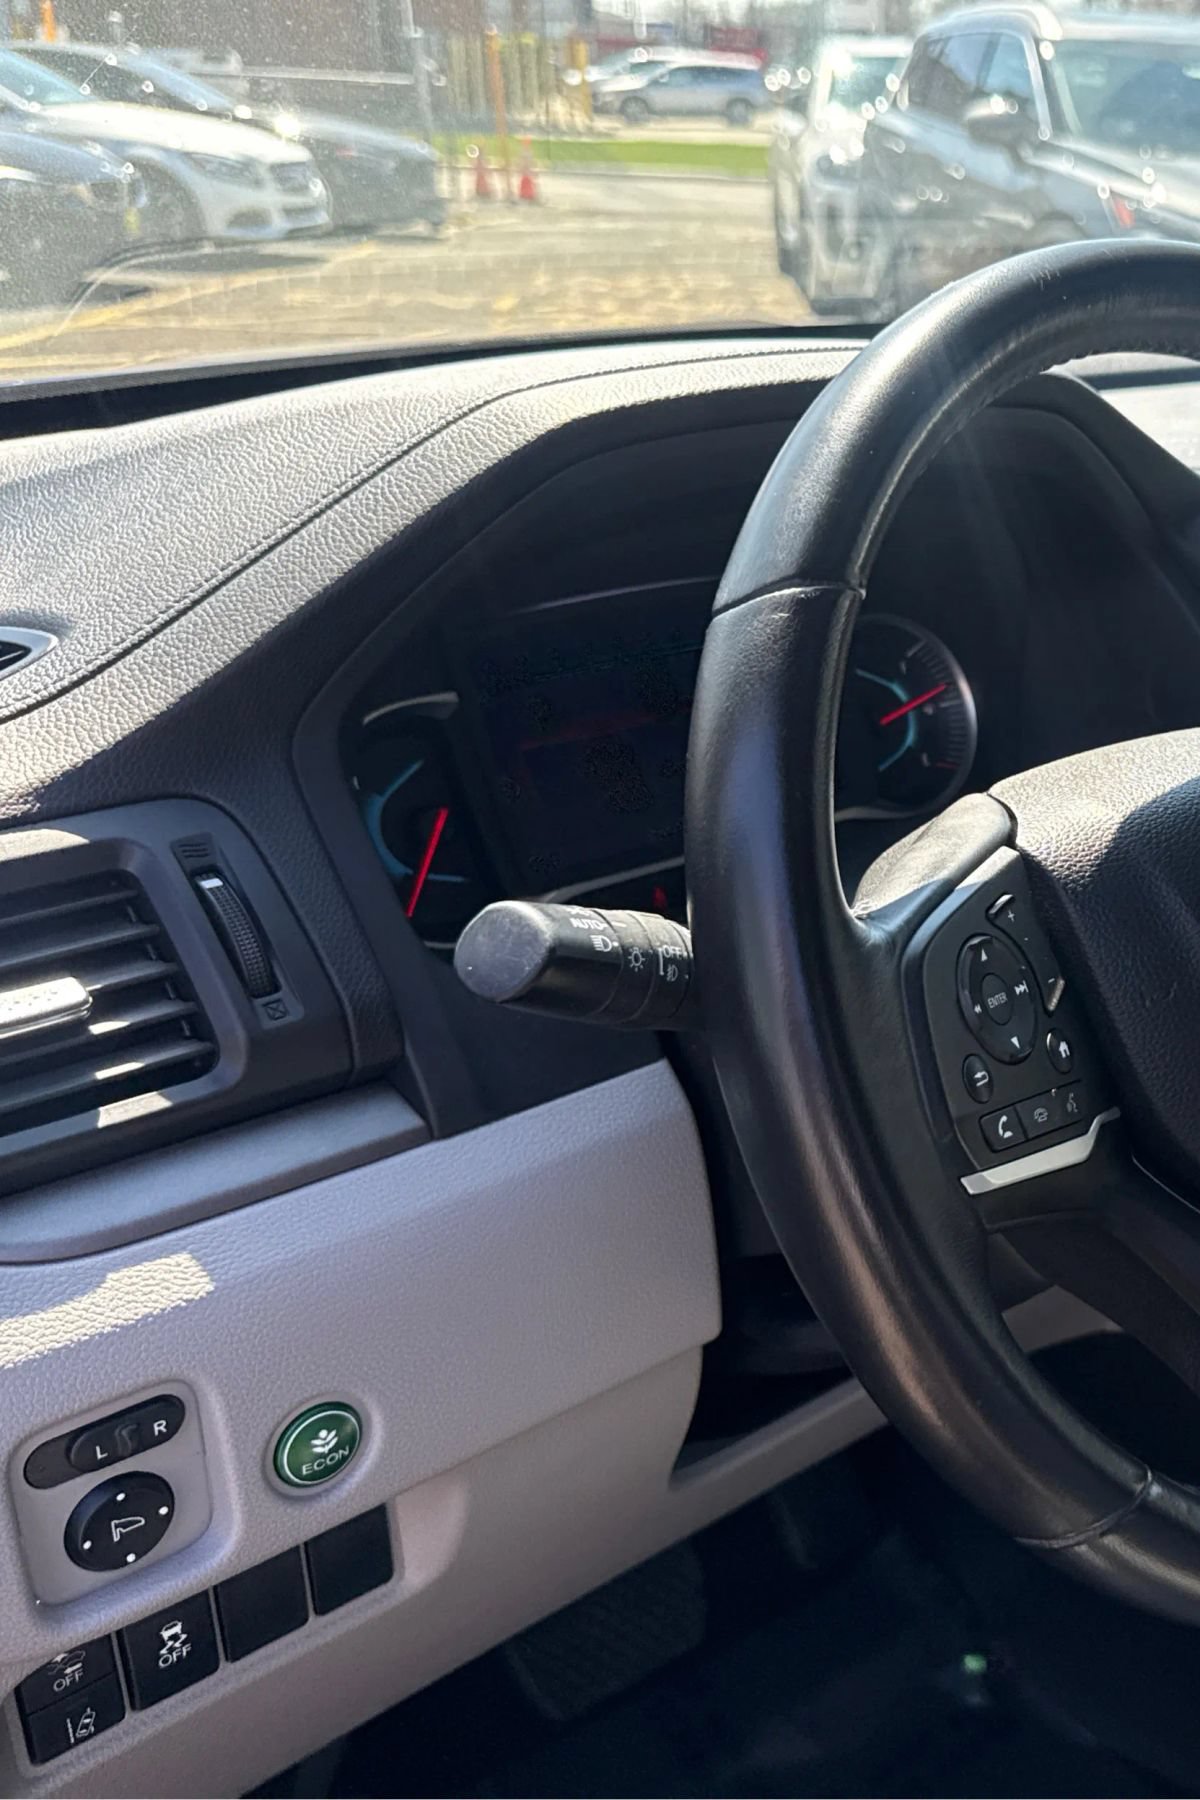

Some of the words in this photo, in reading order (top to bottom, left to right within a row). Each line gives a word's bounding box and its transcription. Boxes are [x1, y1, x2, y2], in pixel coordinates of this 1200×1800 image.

[569, 917, 606, 931] AUTO
[663, 944, 682, 959] OFF
[987, 991, 1008, 1009] ENTER
[153, 1418, 168, 1437] R
[95, 1445, 108, 1460] L
[301, 1445, 350, 1477] ECON
[159, 1643, 192, 1669] OFF
[52, 1667, 85, 1693] OFF
